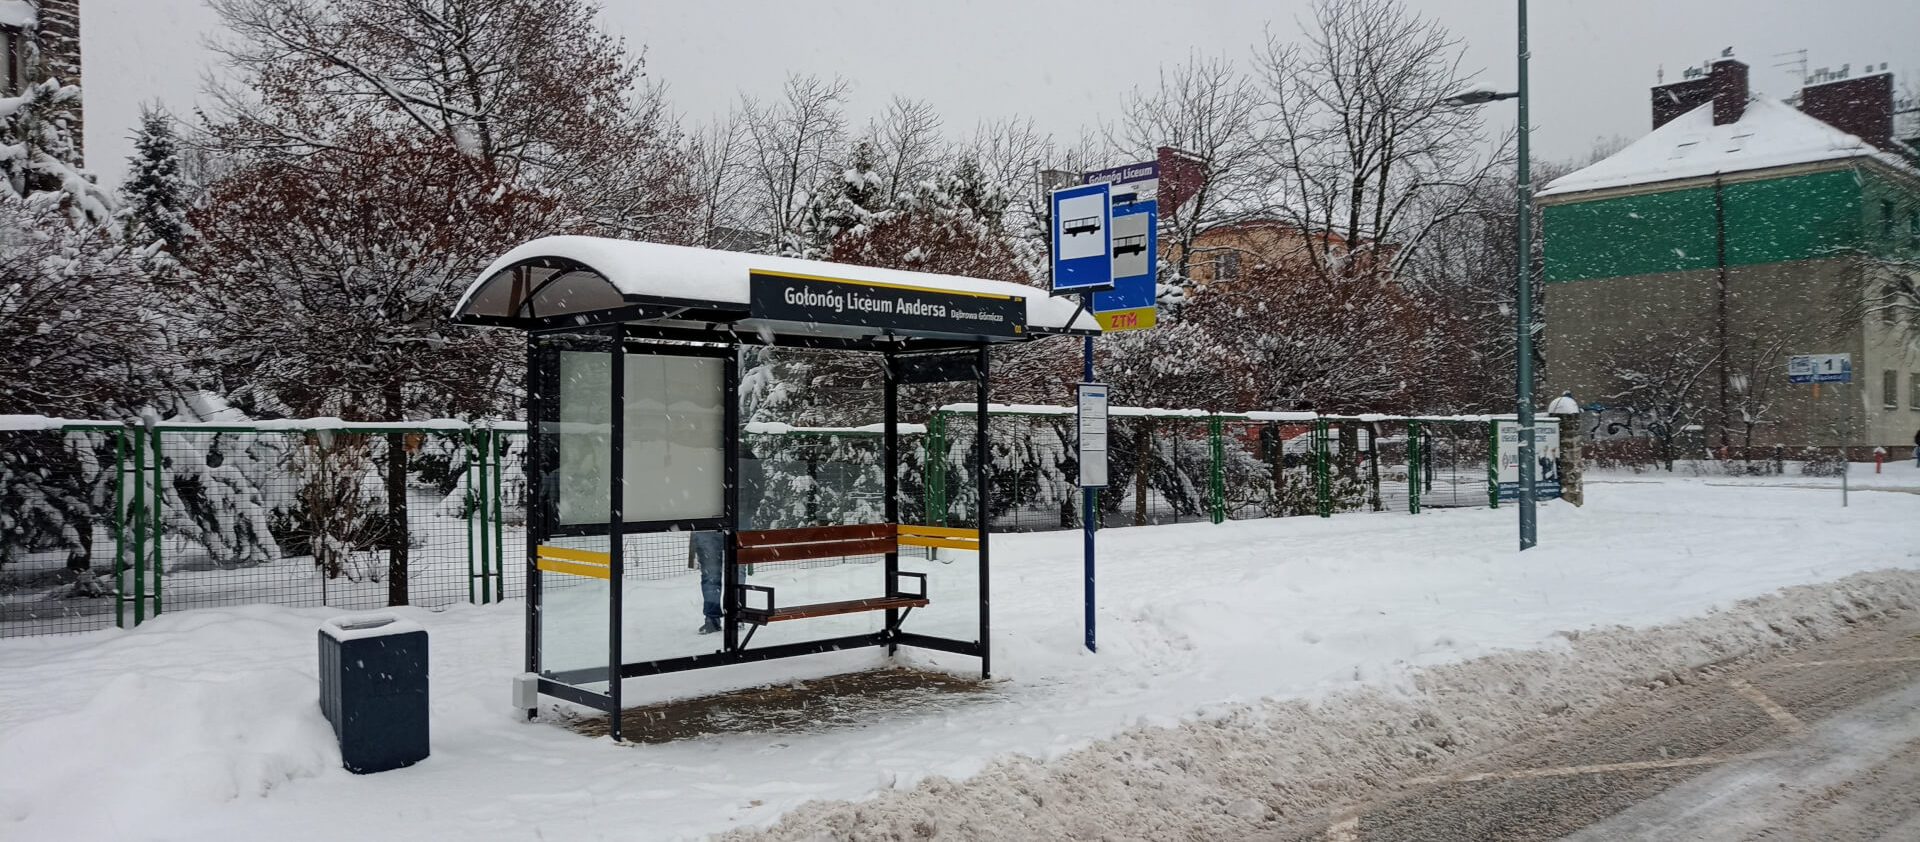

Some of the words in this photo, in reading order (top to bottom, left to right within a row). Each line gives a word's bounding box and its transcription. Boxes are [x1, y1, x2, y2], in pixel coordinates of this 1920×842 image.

[1123, 167, 1152, 180] Liceum
[784, 285, 843, 313] Gołonóg
[847, 292, 893, 314] Liceum
[895, 297, 946, 318] Andersa
[1111, 312, 1137, 328] ZTM
[1824, 358, 1833, 371] 1
